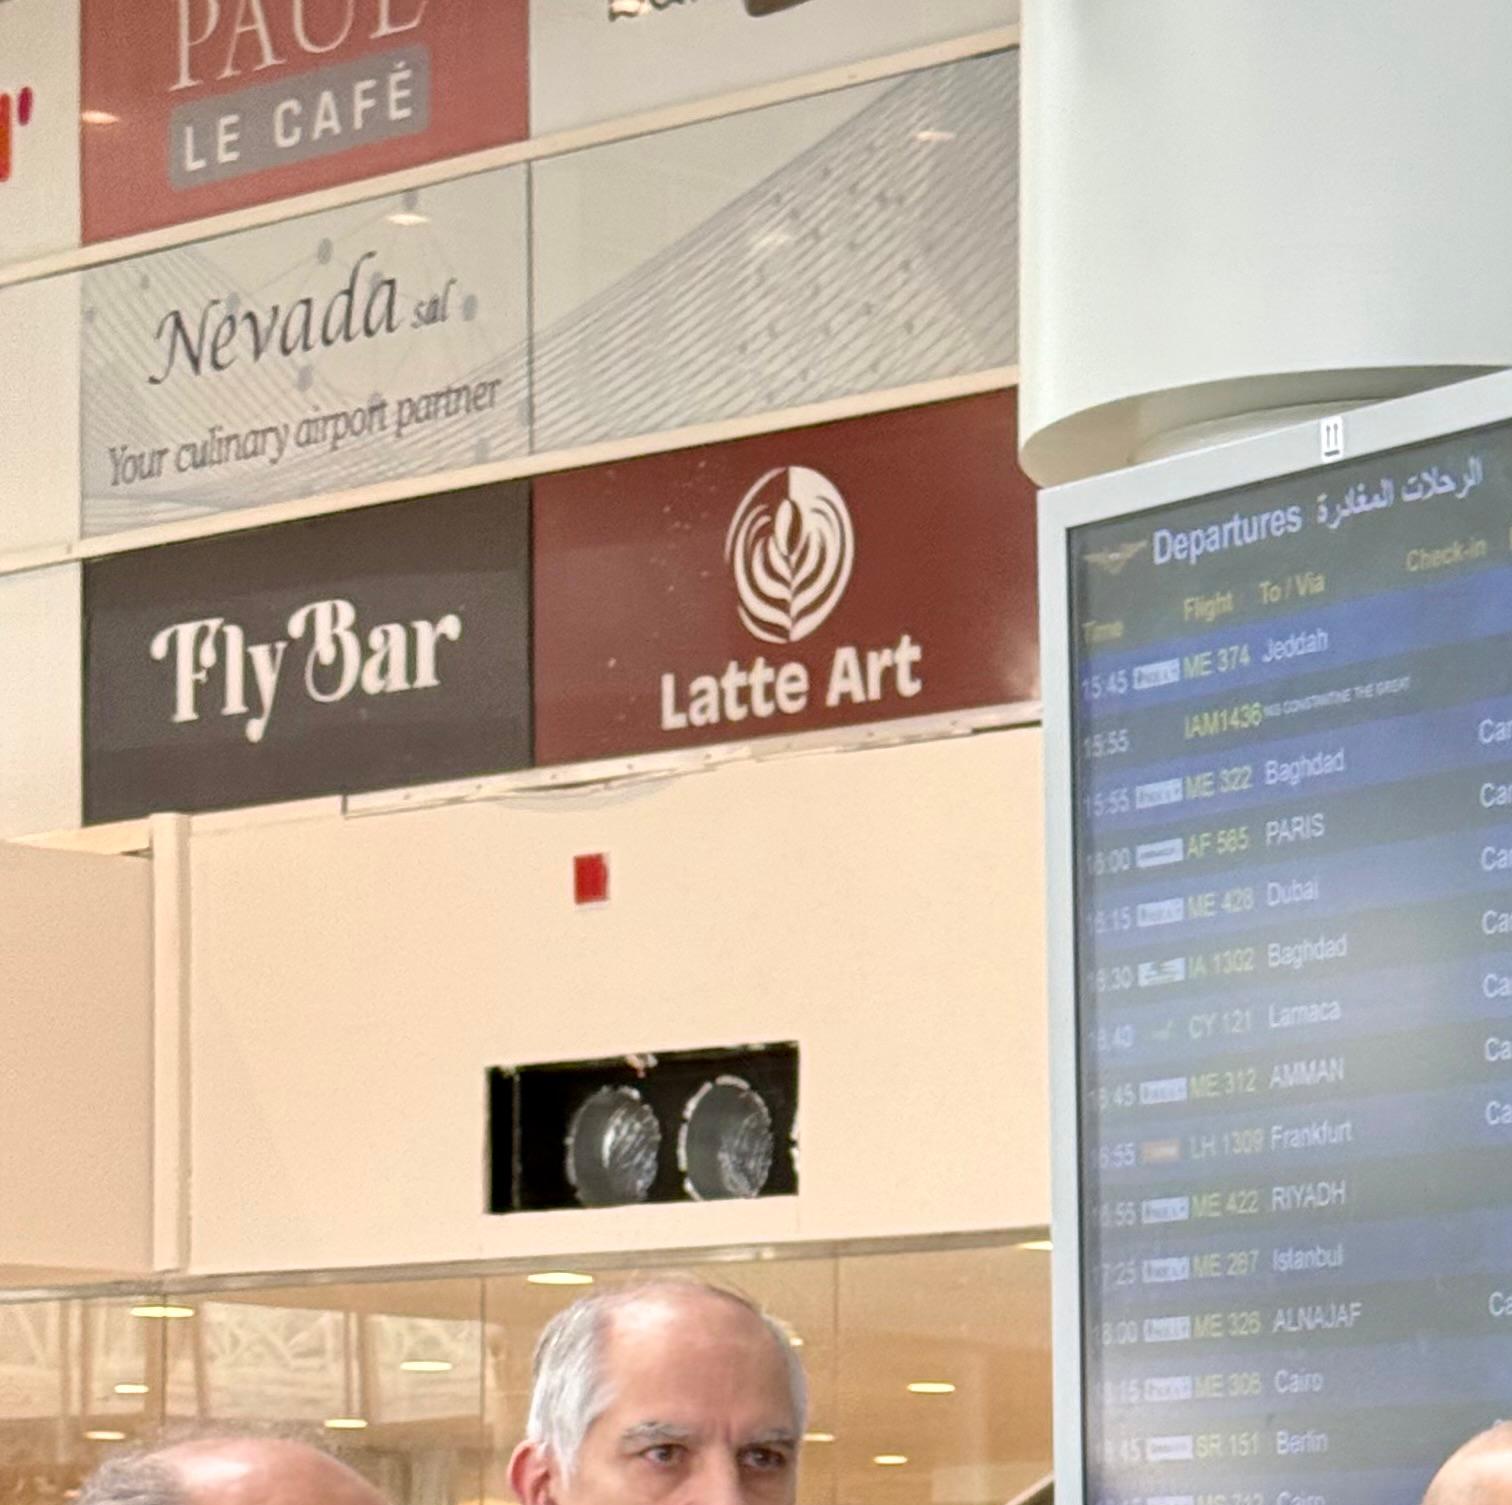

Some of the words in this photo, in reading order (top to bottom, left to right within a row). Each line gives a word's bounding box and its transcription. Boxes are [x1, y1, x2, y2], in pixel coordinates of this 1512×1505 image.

[184, 114, 241, 171] LE
[273, 60, 413, 148] CAFÉ
[147, 251, 400, 385] Nevada
[410, 278, 457, 329] sal
[108, 443, 170, 487] Your
[174, 423, 289, 465] culinary
[293, 397, 390, 452] airport
[397, 378, 502, 437] partner
[1152, 504, 1302, 565] Departures
[1183, 589, 1234, 622] Flight
[1259, 580, 1281, 604] To
[1295, 571, 1326, 597] Via
[1406, 537, 1488, 573] Check-in
[150, 617, 288, 743] Fly
[287, 599, 461, 703] Bar
[1184, 651, 1213, 679] ME
[1217, 645, 1251, 673] 374
[1262, 627, 1328, 663] Jeddah
[660, 656, 810, 730] Latte
[825, 634, 923, 707] Art
[1185, 772, 1215, 800] ME
[1263, 749, 1346, 787] Baghdad
[1187, 831, 1213, 859] AF
[1265, 812, 1326, 847] PARIS
[1187, 892, 1217, 919] ME
[1266, 879, 1319, 907] Dubai
[1267, 931, 1349, 970] Baghdad
[1188, 1012, 1217, 1040] CY
[1221, 1008, 1254, 1035] 121
[1190, 1072, 1220, 1099] ME
[1224, 1067, 1256, 1095] 312
[1269, 1055, 1345, 1091] AMMAN
[1191, 1132, 1217, 1160] LH
[1270, 1119, 1354, 1152] Frankfurt
[1191, 1193, 1224, 1219] ME
[1225, 1189, 1260, 1216] 422
[1271, 1179, 1347, 1212] RIYADH
[1192, 1253, 1223, 1279] ME
[1272, 1242, 1343, 1273] Istanbul
[1193, 1313, 1225, 1339] ME
[1272, 1300, 1362, 1335] ALNAJAF
[1194, 1373, 1225, 1399] ME
[1274, 1367, 1325, 1394] Cairo
[1275, 1428, 1329, 1456] Berlin
